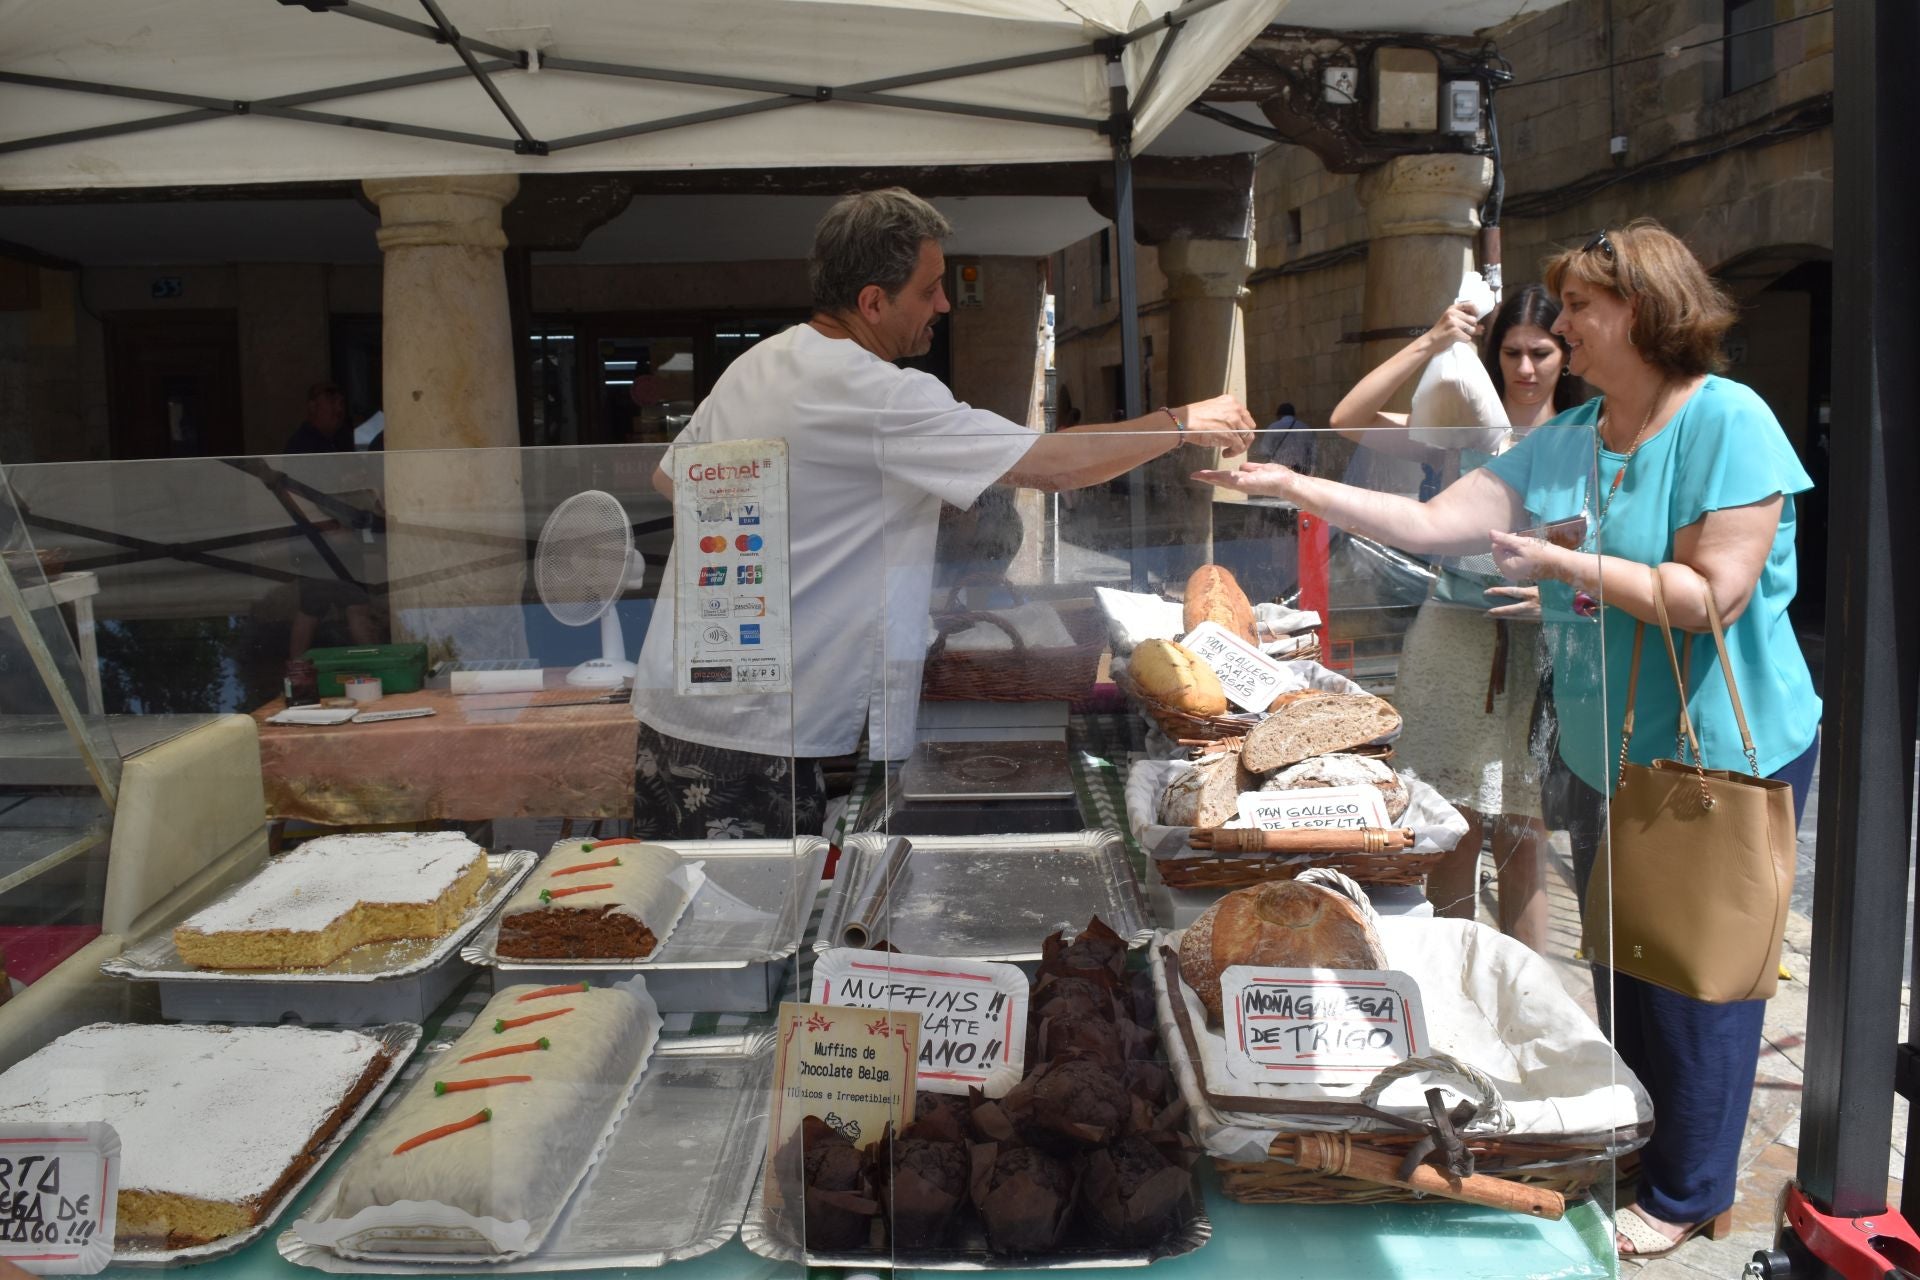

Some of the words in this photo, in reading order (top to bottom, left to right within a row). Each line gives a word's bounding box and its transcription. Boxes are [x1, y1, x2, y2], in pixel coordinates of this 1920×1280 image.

[688, 460, 760, 482] Getnet
[1197, 647, 1215, 661] DE
[1205, 636, 1228, 654] PAN
[1225, 651, 1276, 686] GALLEGO
[1216, 669, 1254, 697] PASAS
[1256, 806, 1281, 819] PAN
[1286, 804, 1359, 818] GALLEGO
[1263, 820, 1285, 830] DE
[1250, 1026, 1280, 1044] DE
[814, 1041, 858, 1060] Muffins
[863, 1043, 876, 1060] de
[800, 1060, 853, 1079] Chocolate
[858, 1066, 890, 1082] Belga
[56, 1193, 90, 1221] DE
